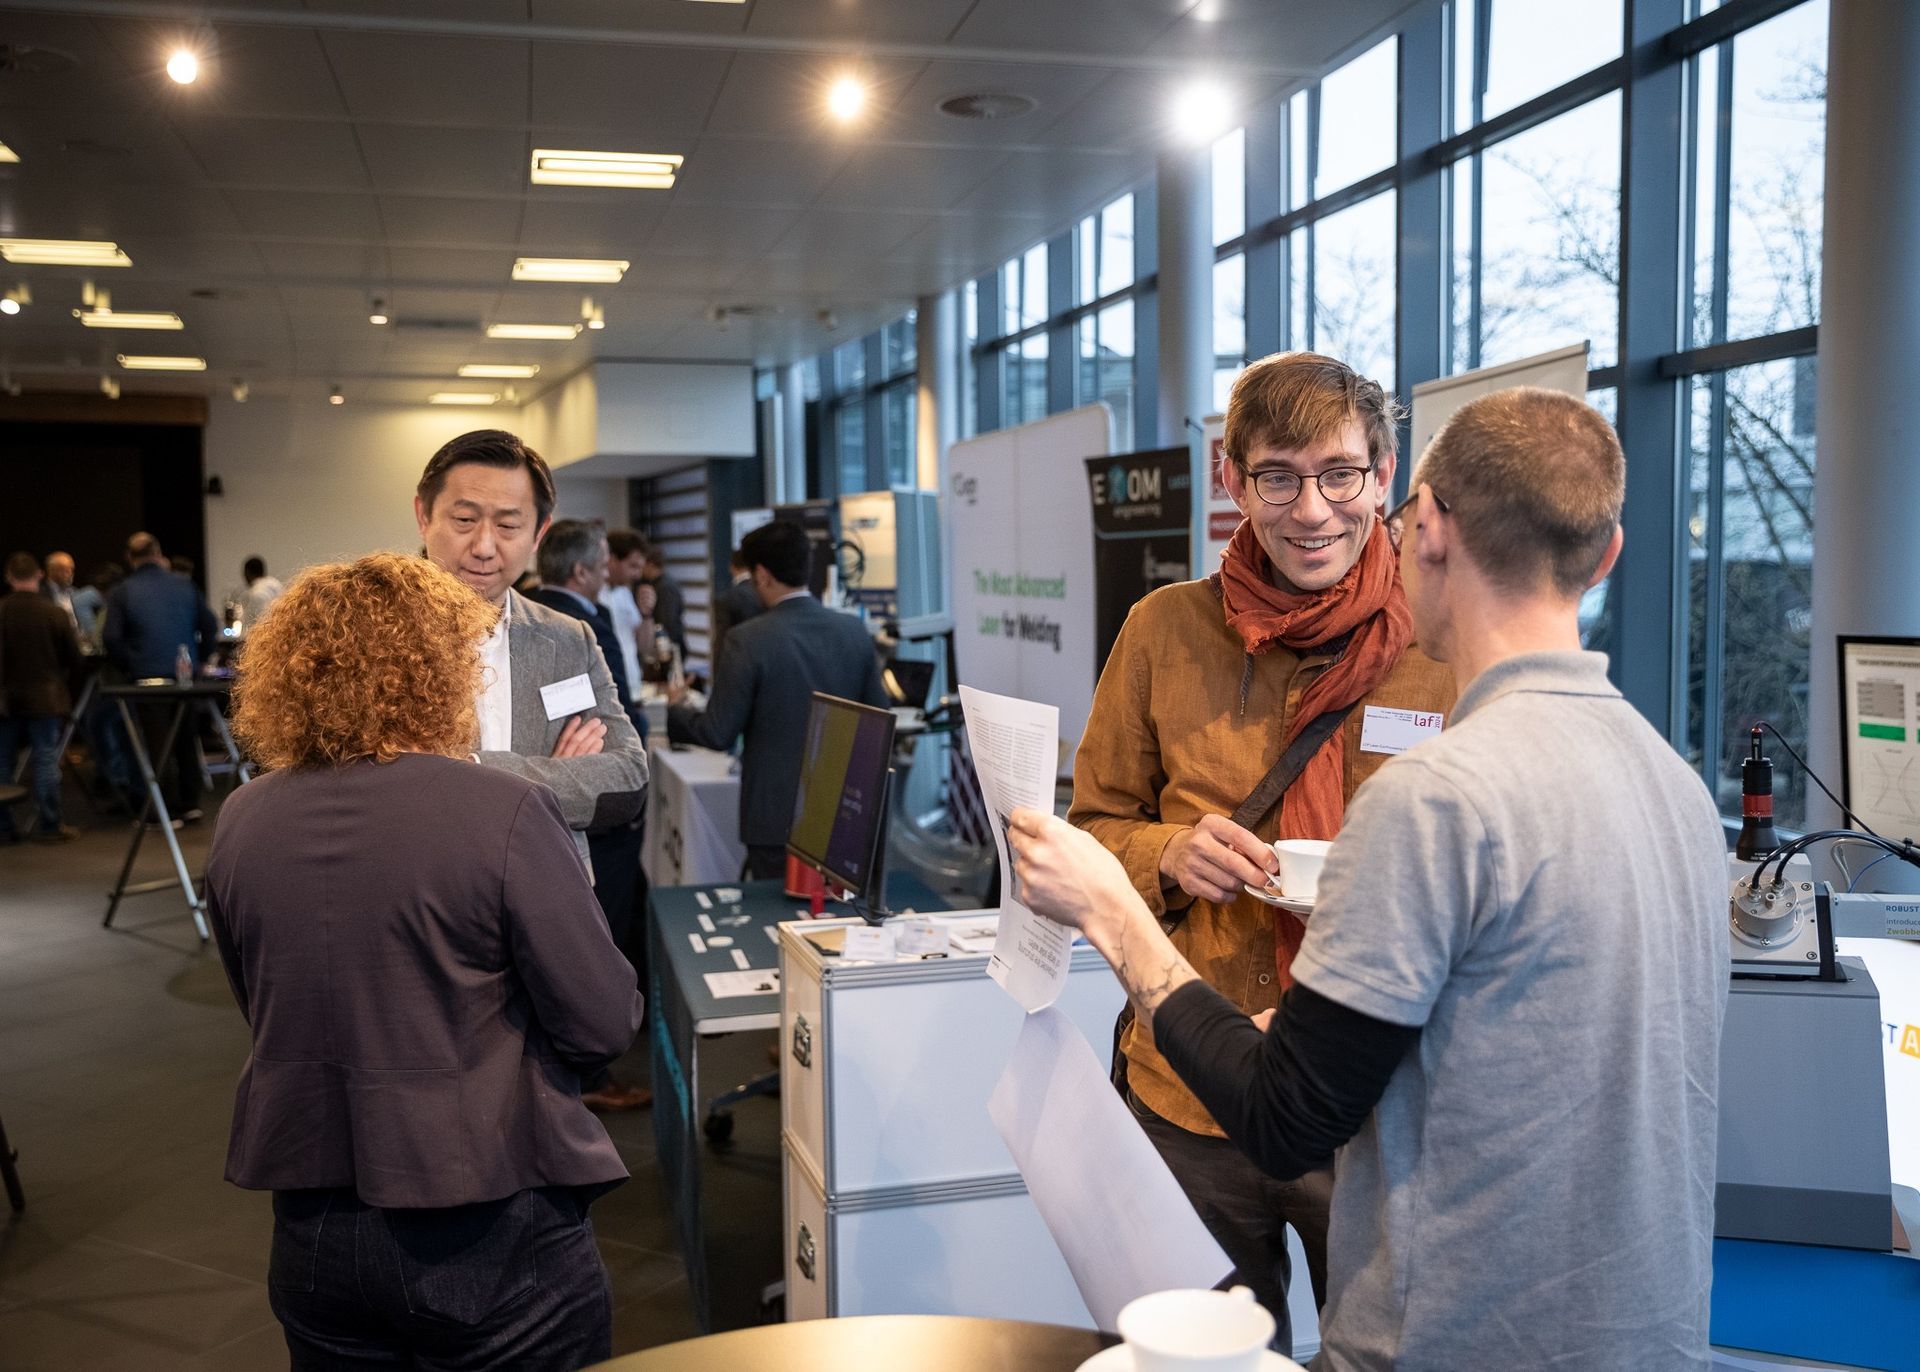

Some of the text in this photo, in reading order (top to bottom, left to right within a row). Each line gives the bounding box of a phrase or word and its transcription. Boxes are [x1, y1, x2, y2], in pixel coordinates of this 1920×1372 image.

[1092, 467, 1161, 505] EOM
[1016, 571, 1066, 600] Advanced
[1002, 610, 1015, 638] for
[1018, 612, 1061, 653] Welding
[1414, 714, 1435, 728] laf
[1885, 905, 1920, 913] ROBUST
